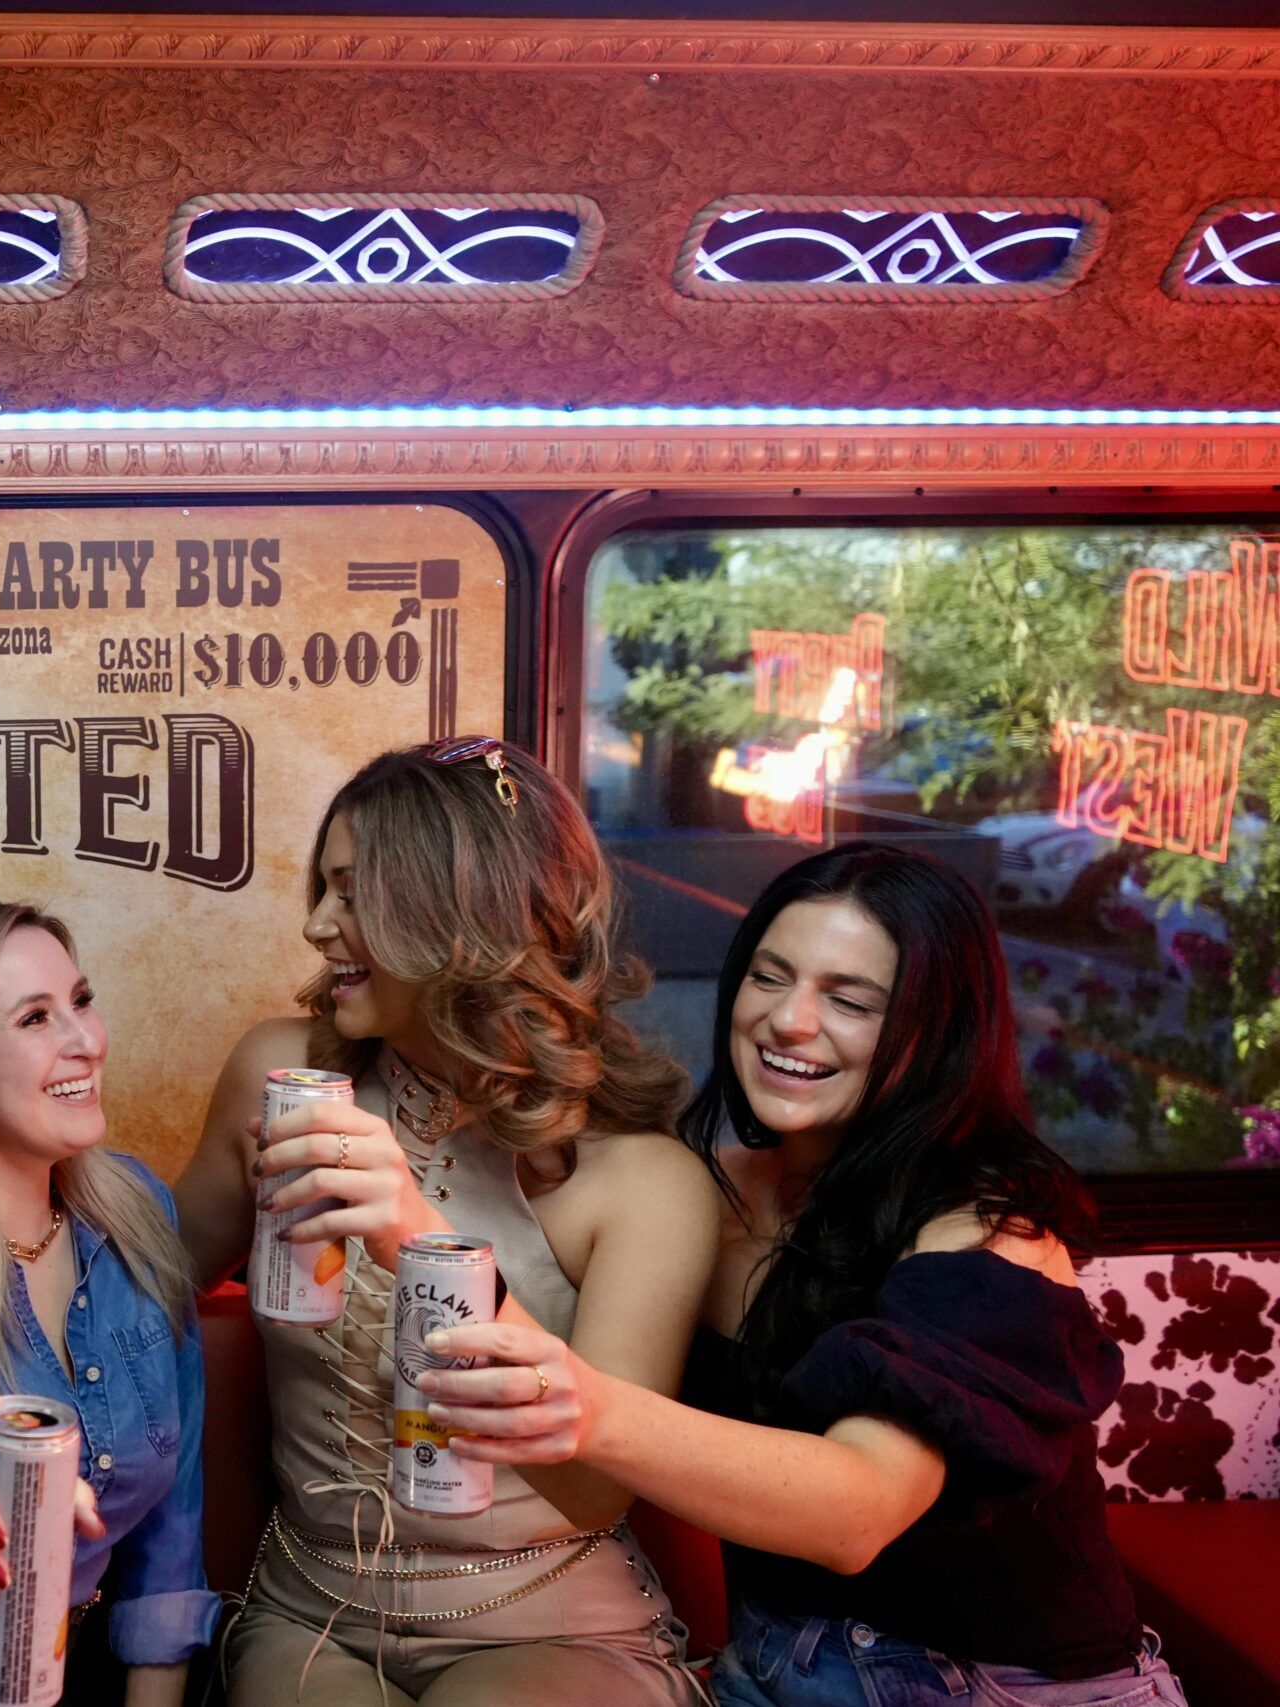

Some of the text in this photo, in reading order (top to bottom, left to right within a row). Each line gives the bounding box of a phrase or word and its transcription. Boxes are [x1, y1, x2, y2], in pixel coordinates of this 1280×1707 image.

[175, 537, 283, 608] BUS
[98, 636, 172, 671] CASH
[192, 629, 423, 691] $10,000
[96, 671, 174, 694] REWARD
[414, 1282, 475, 1320] CLAW
[399, 1357, 418, 1383] HAR
